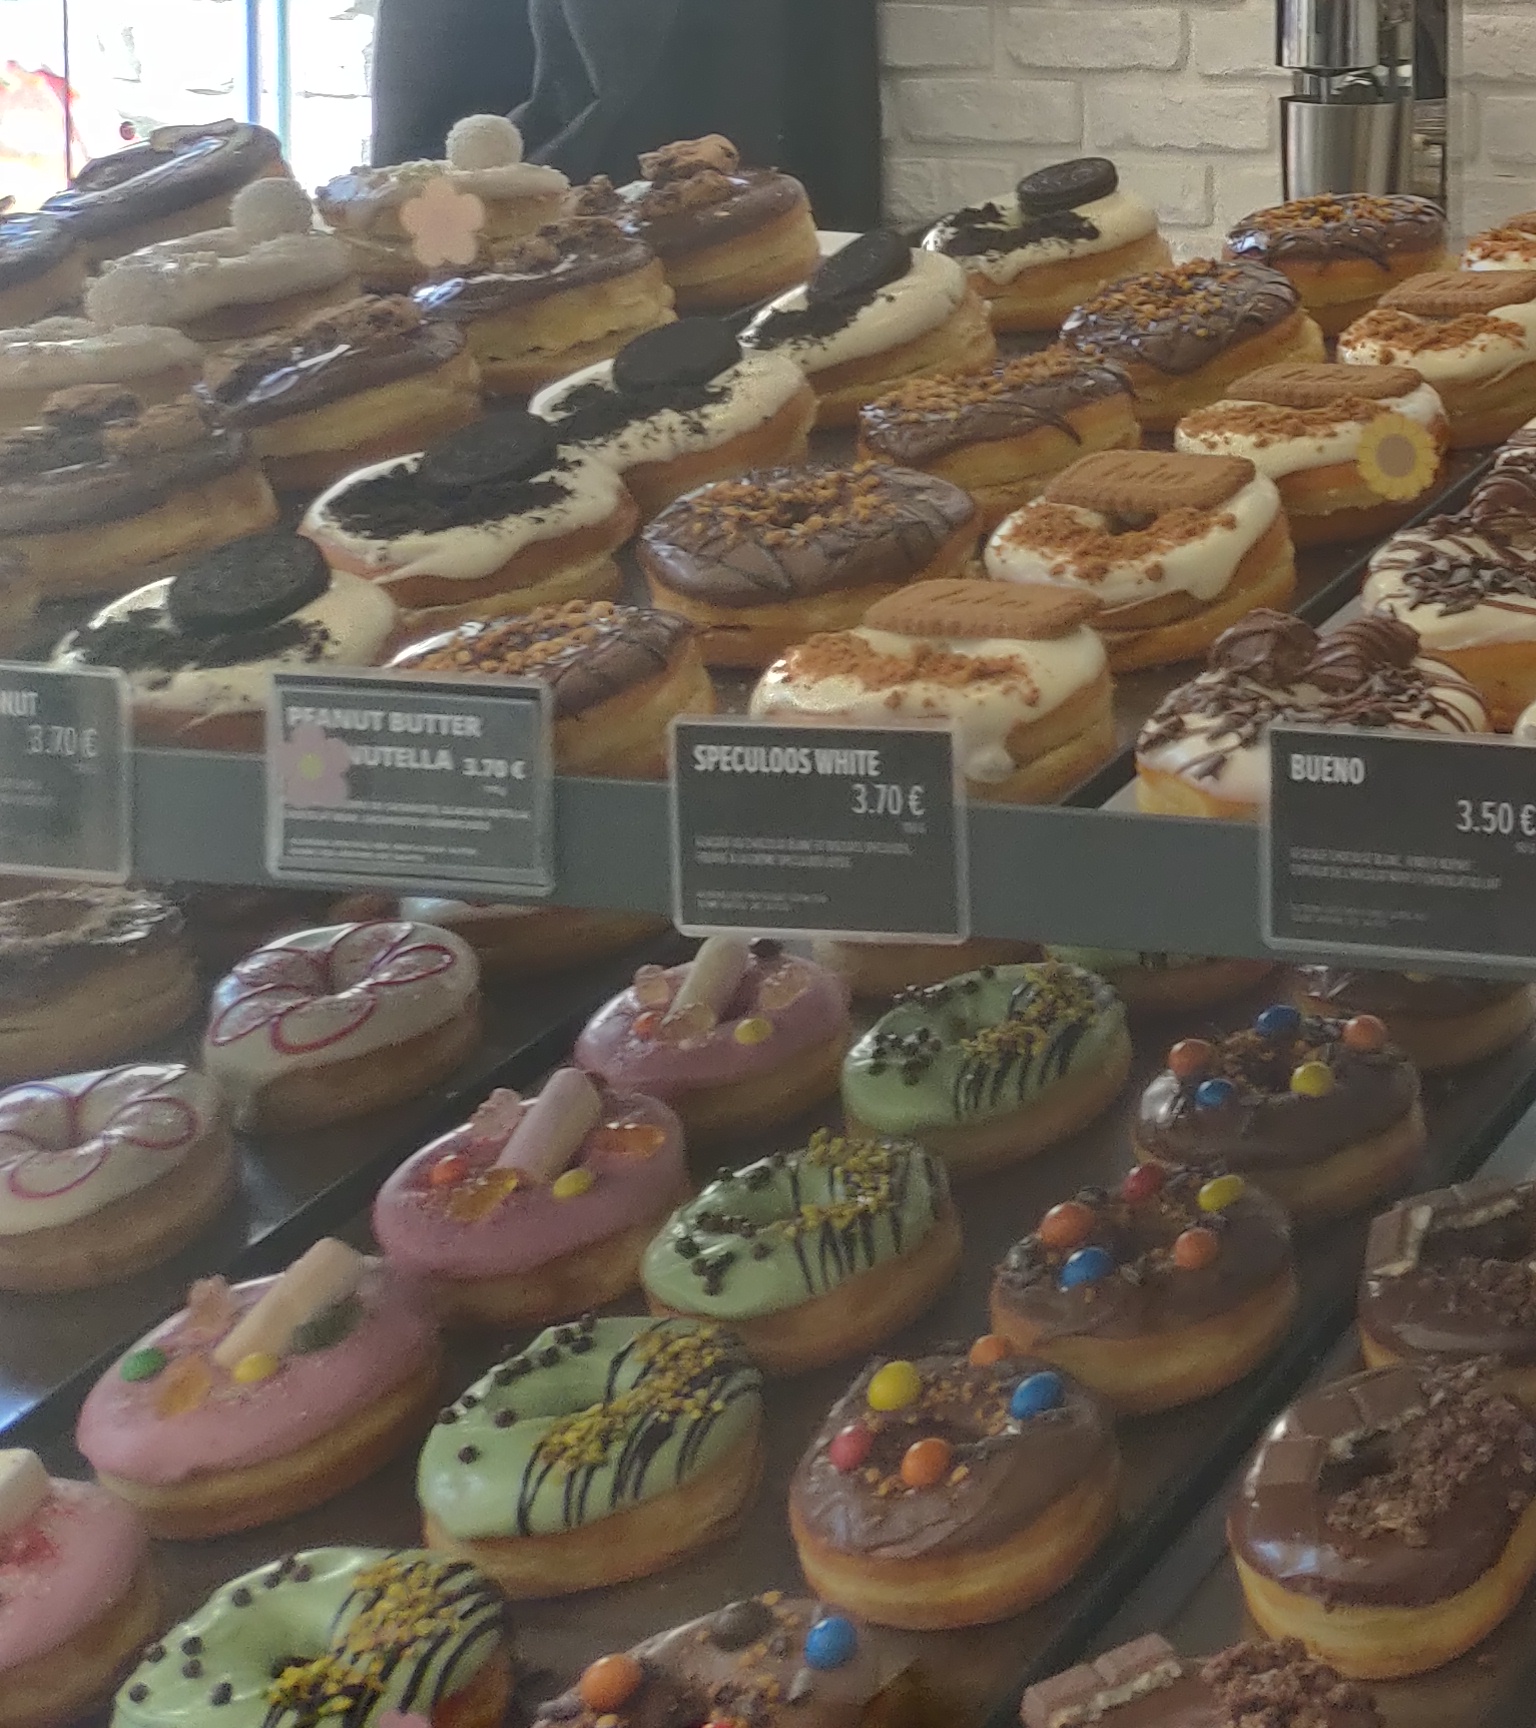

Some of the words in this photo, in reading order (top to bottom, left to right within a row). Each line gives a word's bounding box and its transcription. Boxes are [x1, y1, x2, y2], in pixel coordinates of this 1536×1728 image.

[287, 706, 382, 731] PEANUT
[388, 712, 482, 737] BUTTER
[693, 744, 812, 774] SPECULOOS
[814, 749, 880, 777] WHITE
[1290, 753, 1365, 785] BUENO
[852, 784, 901, 814] 3.70
[908, 786, 925, 815] €
[1457, 800, 1513, 834] 3.50
